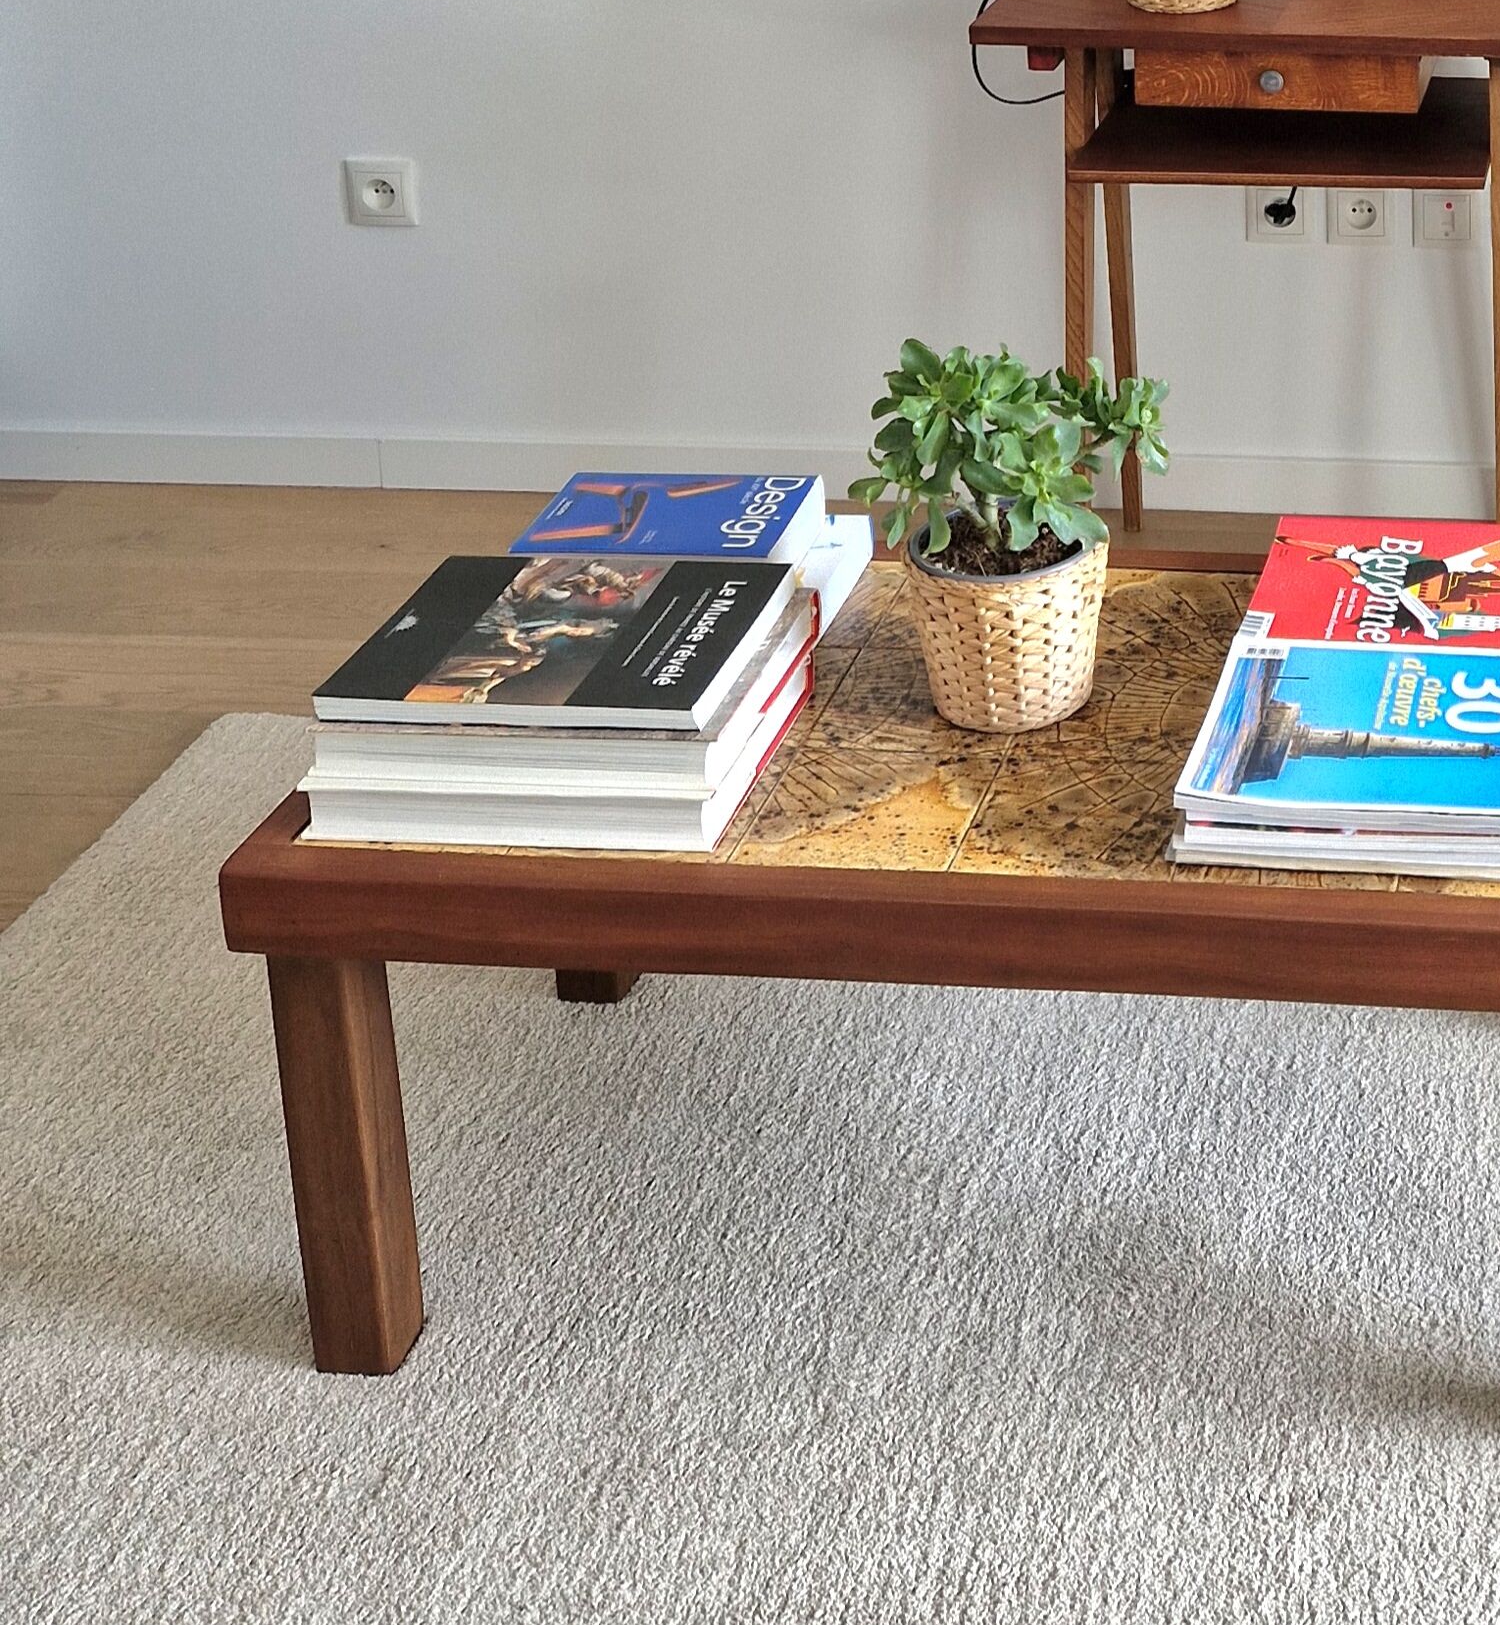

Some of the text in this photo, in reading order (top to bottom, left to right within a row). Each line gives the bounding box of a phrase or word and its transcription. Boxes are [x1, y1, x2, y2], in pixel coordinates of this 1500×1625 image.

[720, 477, 807, 548] Design
[718, 580, 748, 597] Le
[1350, 535, 1424, 644] Bayonne
[685, 598, 735, 642] Musée
[651, 643, 698, 687] révélé
[1416, 677, 1447, 728] chefs-
